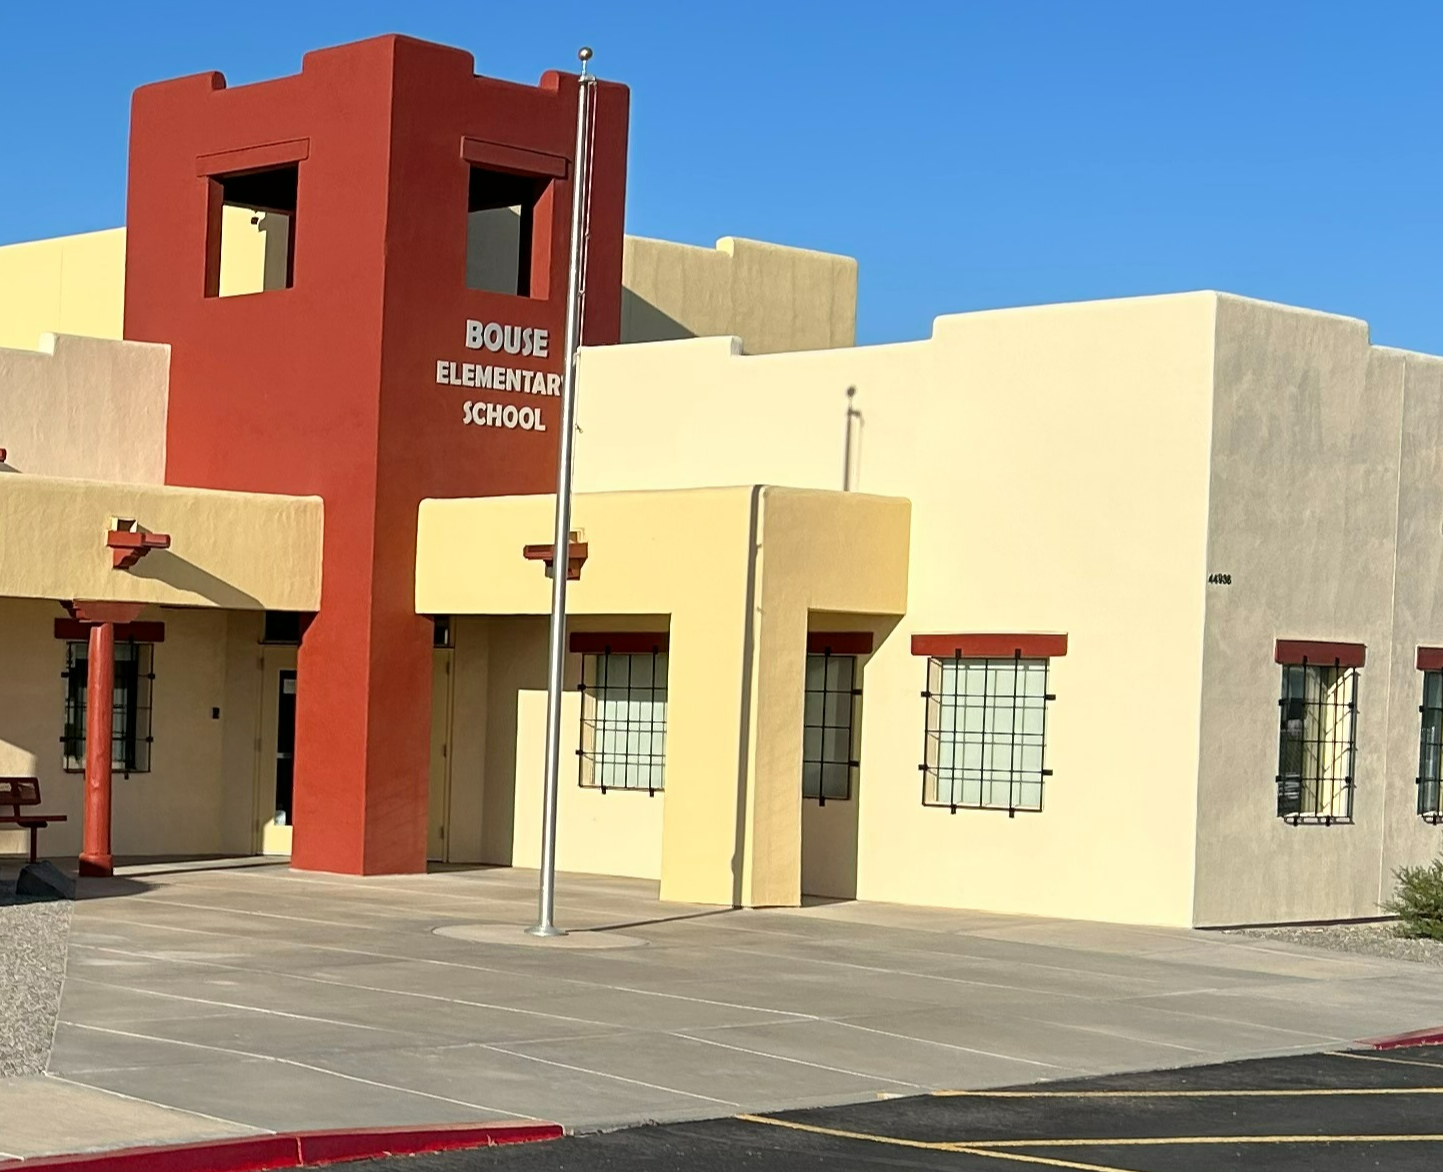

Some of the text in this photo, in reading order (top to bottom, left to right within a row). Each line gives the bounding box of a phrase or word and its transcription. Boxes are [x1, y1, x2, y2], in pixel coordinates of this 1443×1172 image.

[465, 319, 549, 357] BOUSE
[436, 360, 564, 396] ELEMENTAR
[462, 400, 546, 431] SCHOOL
